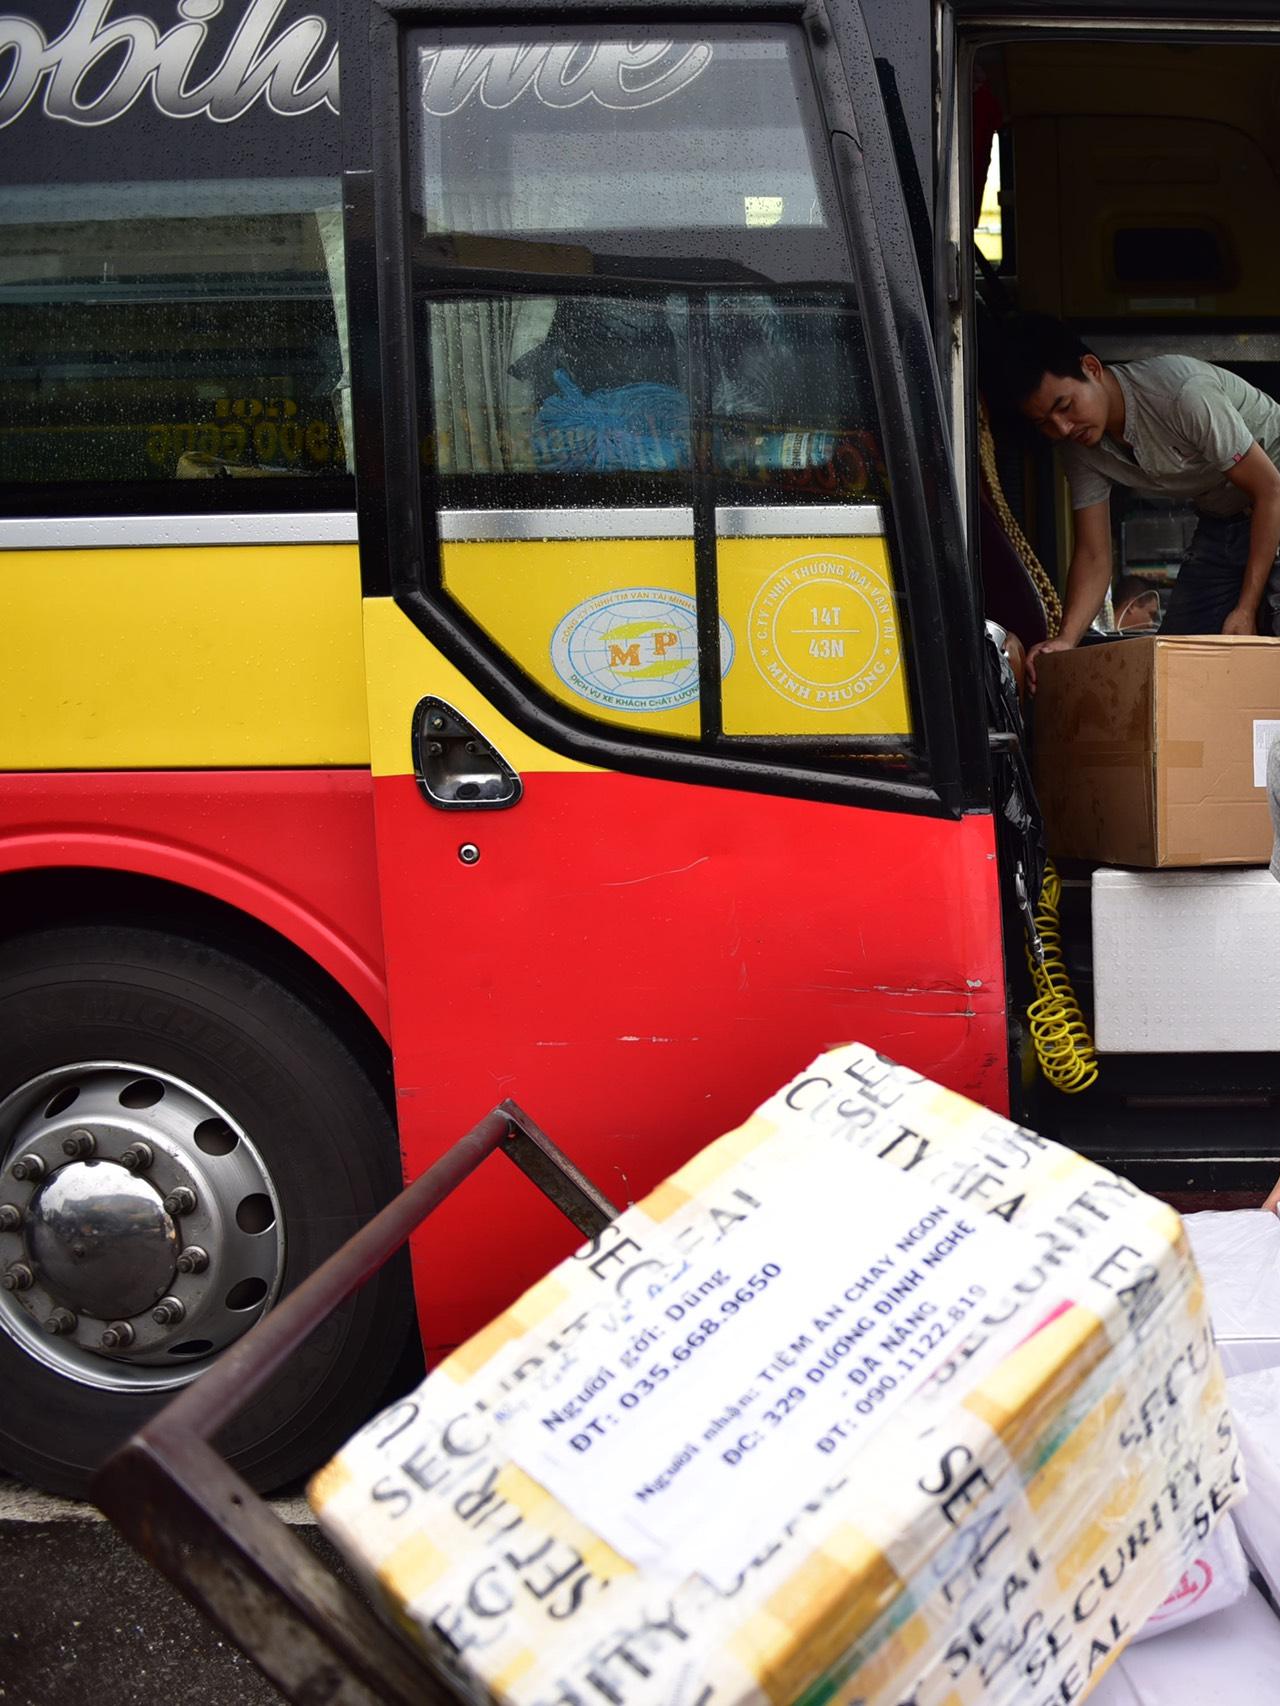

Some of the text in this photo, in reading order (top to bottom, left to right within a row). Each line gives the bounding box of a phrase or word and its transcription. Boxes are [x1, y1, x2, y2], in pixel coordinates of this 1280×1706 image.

[811, 607, 841, 626] 14T
[608, 631, 678, 667] M P
[808, 639, 845, 658] 43N
[570, 673, 589, 692] DỊCH
[615, 696, 648, 707] KHÁCH
[674, 684, 700, 702] LƯỢN
[767, 660, 887, 703] MINH PHƯƠNG
[844, 1255, 895, 1302] CHAY
[896, 1205, 949, 1253] NGON
[665, 1268, 731, 1322] Dũng
[569, 1414, 619, 1454] ĐT:
[620, 1262, 782, 1409] 035.668.9650
[722, 1427, 765, 1467] ĐC:
[763, 1386, 807, 1425] 329
[816, 1418, 859, 1454] ĐT:
